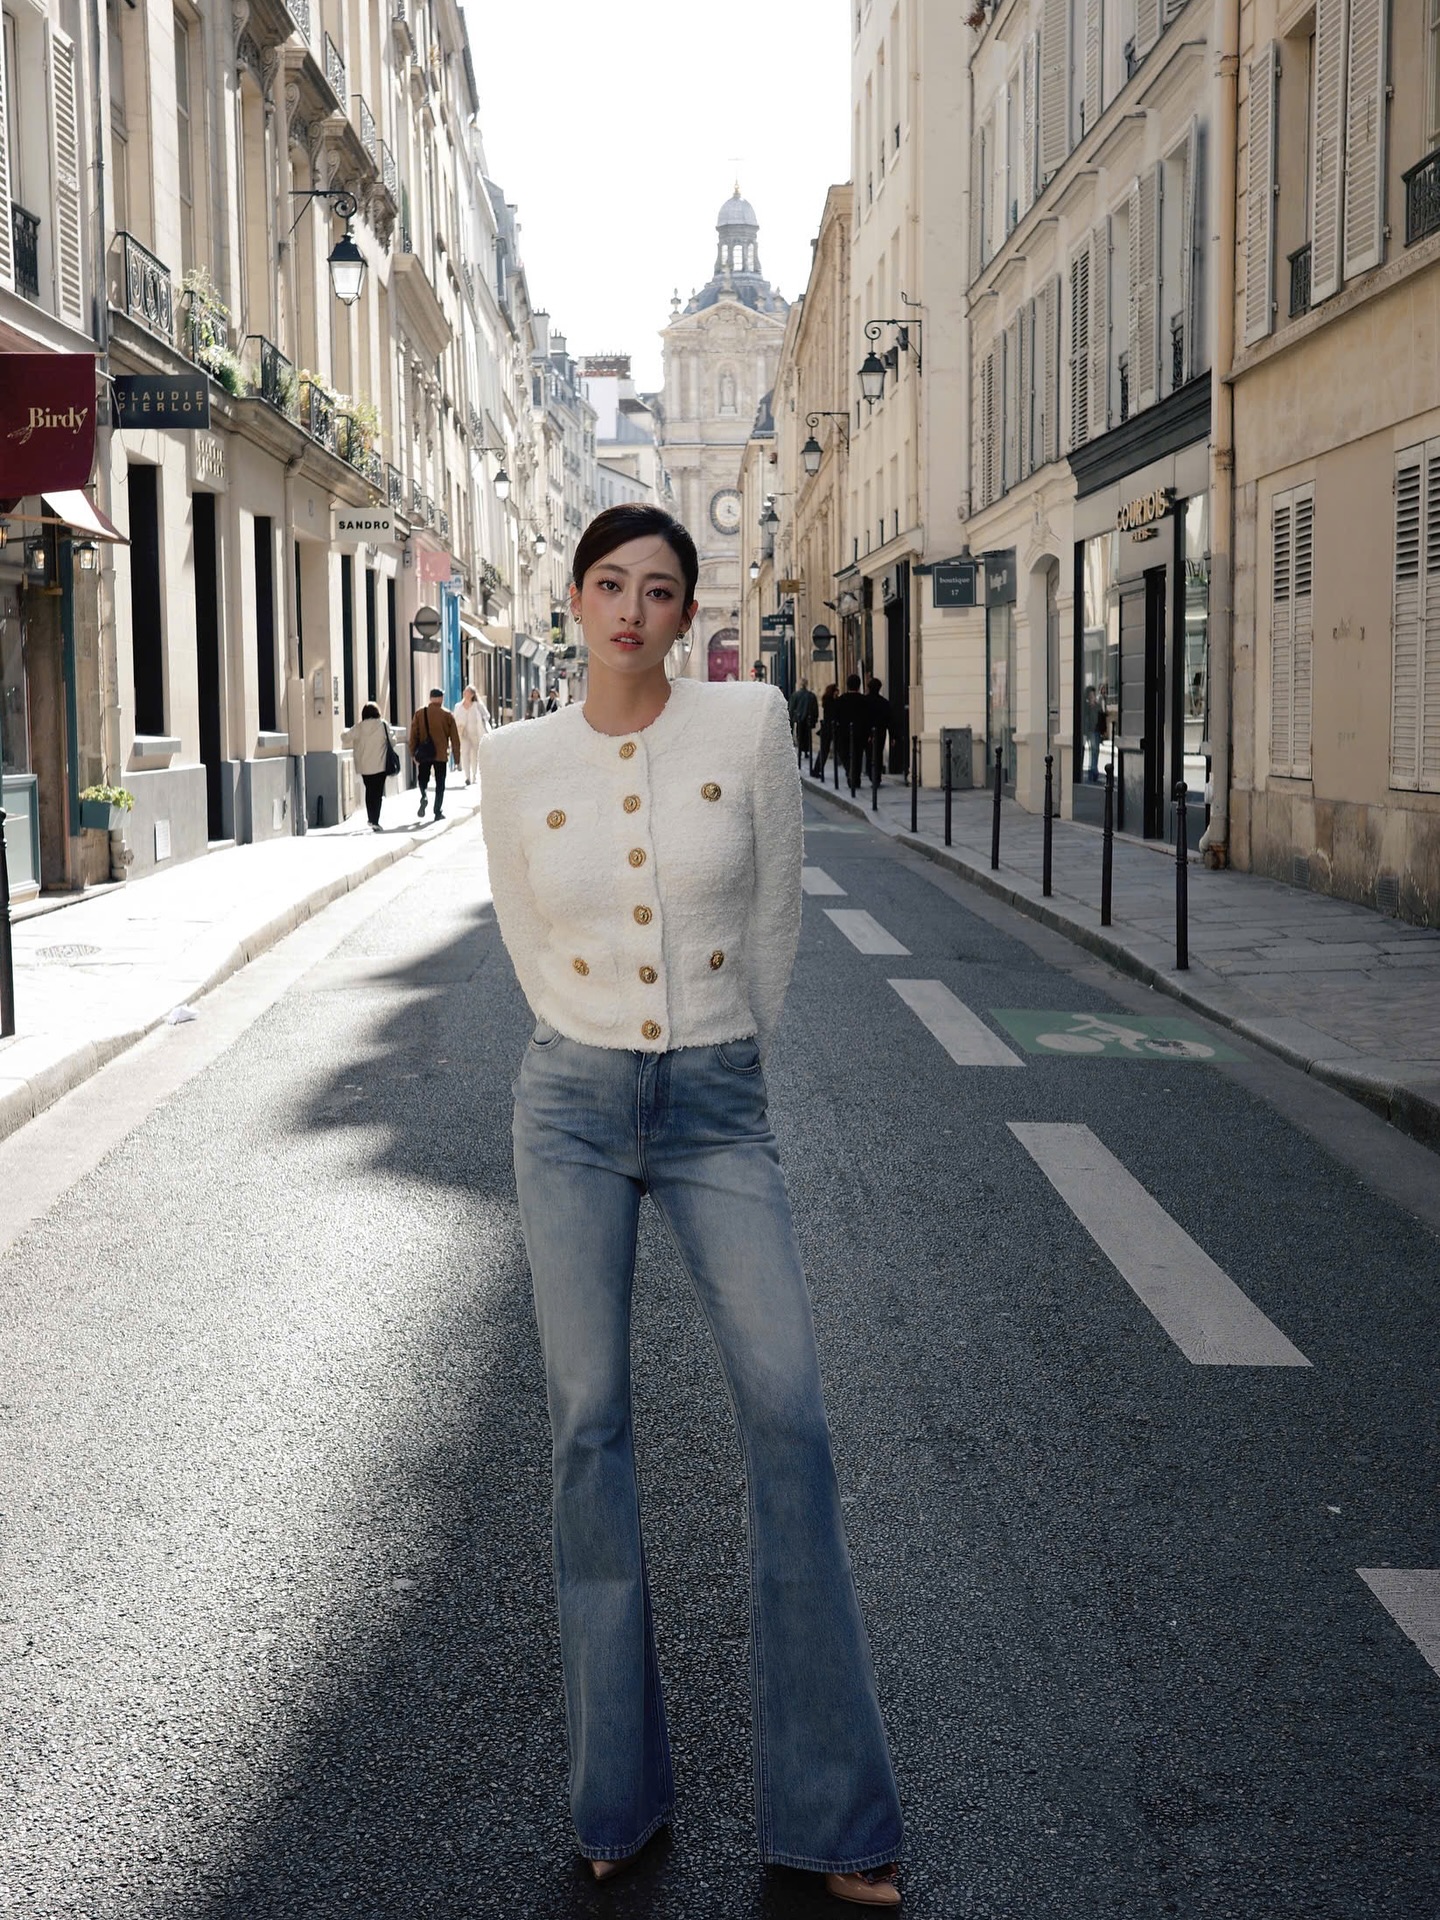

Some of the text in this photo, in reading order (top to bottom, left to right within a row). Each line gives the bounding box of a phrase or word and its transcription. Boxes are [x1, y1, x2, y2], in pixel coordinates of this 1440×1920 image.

[117, 391, 203, 401] CLAUDIE
[118, 402, 204, 412] PIERLOT
[28, 406, 88, 435] Birdy
[1116, 487, 1166, 531] COURTOIS
[338, 520, 390, 530] SANDRO
[939, 577, 970, 585] boutique
